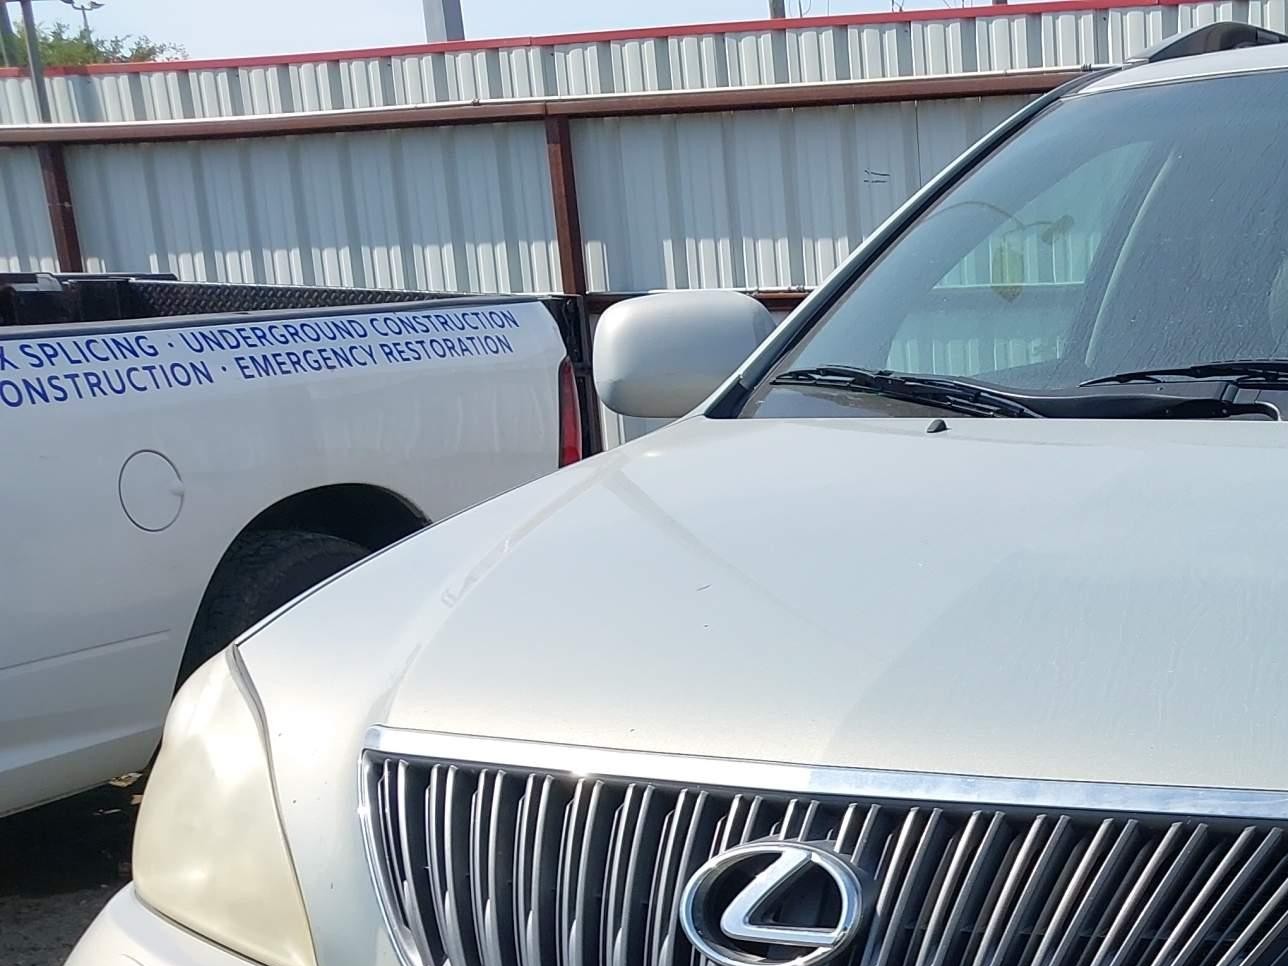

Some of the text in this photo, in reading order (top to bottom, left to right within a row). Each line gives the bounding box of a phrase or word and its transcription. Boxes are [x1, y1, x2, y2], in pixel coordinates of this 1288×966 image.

[19, 335, 159, 368] SPLICING
[179, 319, 369, 353] UNDERGROUND
[369, 310, 520, 337] CONSTRUCTION
[234, 344, 379, 380] EMERGENCY
[377, 334, 514, 364] RESTORATION
